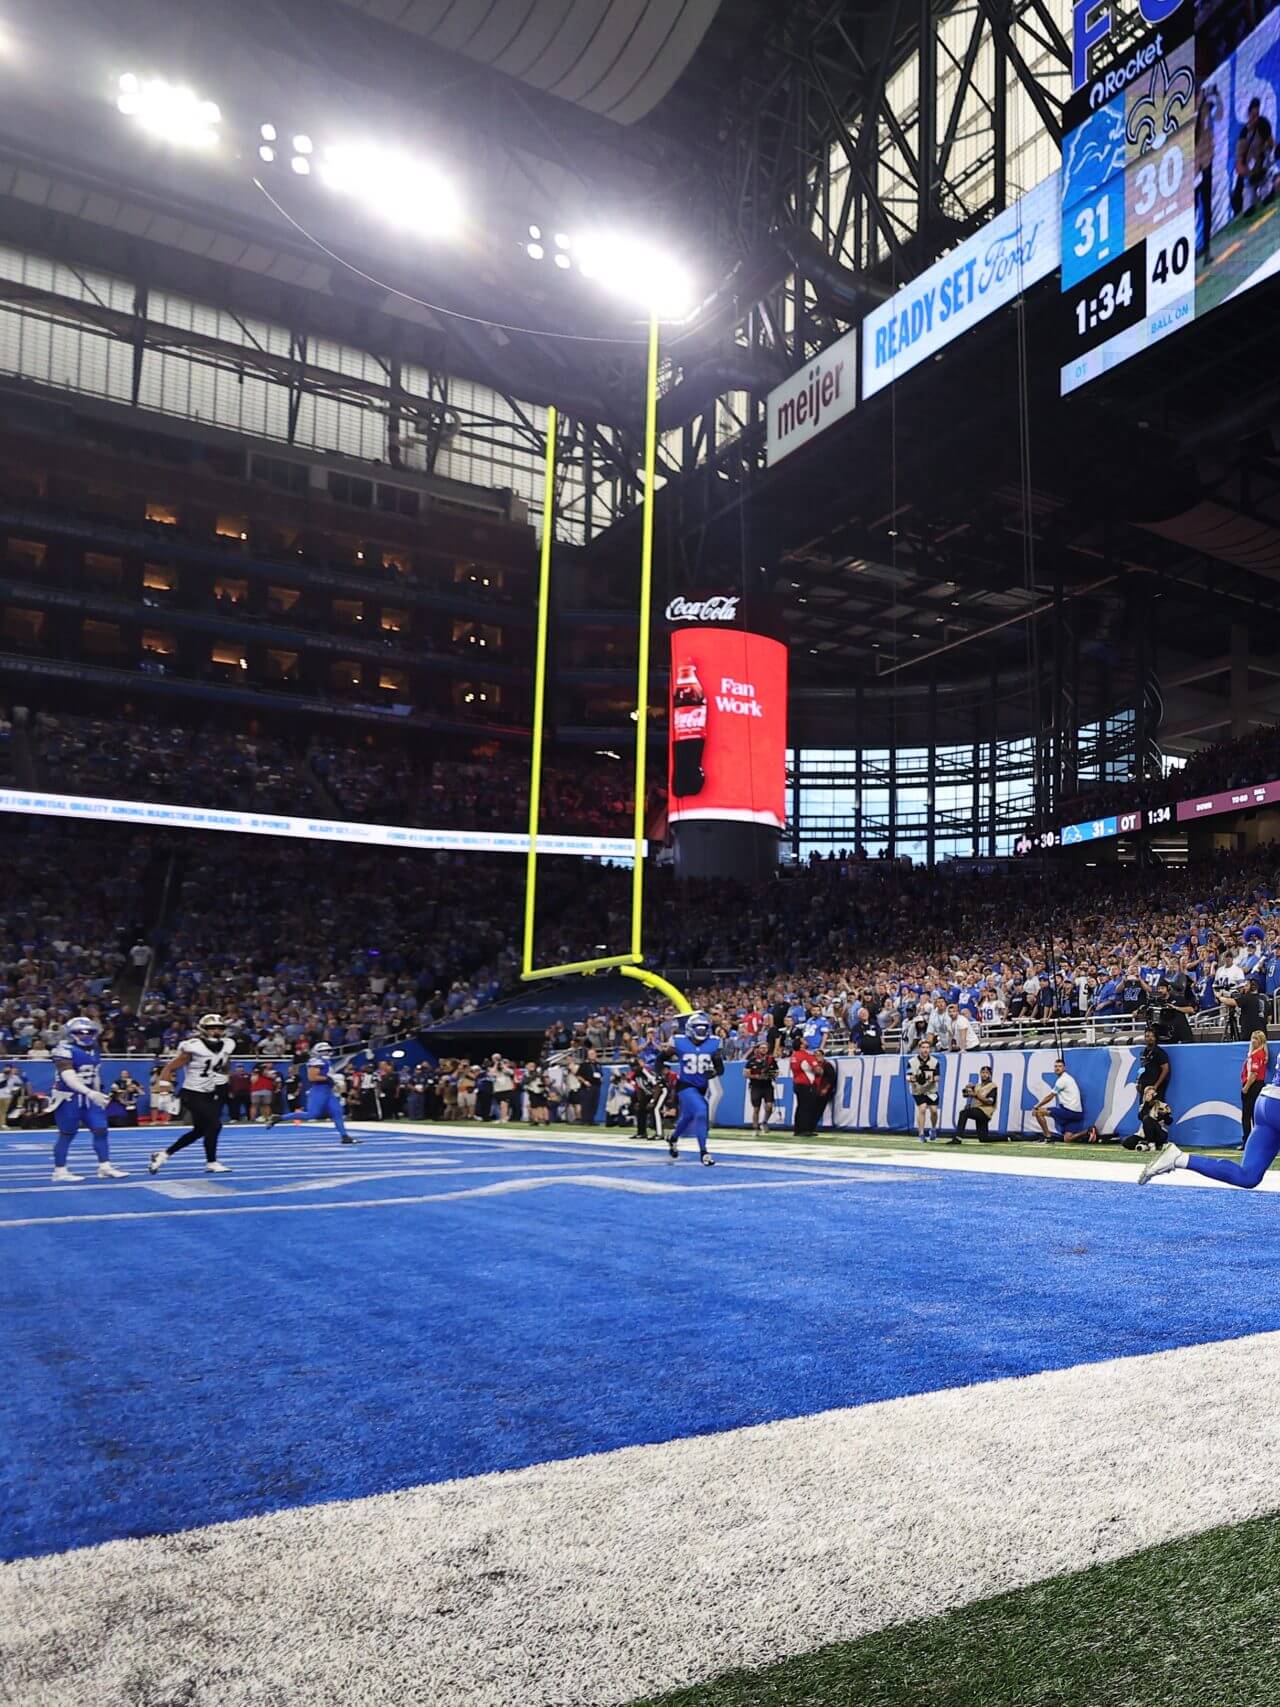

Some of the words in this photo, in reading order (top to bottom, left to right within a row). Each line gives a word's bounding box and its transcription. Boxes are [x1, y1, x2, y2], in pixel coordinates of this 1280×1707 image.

[1104, 33, 1163, 98] Rocket
[1134, 144, 1184, 216] 30
[1074, 194, 1110, 258] 31
[1152, 236, 1190, 285] 40
[875, 287, 936, 370] READY
[939, 257, 978, 323] SET
[978, 222, 1041, 296] Ford
[1076, 270, 1134, 335] 1:34
[1150, 313, 1173, 335] BALL
[1174, 303, 1190, 321] ON
[778, 361, 844, 440] meijer
[720, 677, 755, 698] Fan
[715, 696, 763, 718] Work
[1092, 822, 1105, 835] 31
[1120, 814, 1137, 831] OT
[1148, 807, 1171, 824] 1:34
[1040, 832, 1055, 849] 30
[199, 1058, 223, 1078] 14
[683, 1053, 713, 1075] 36
